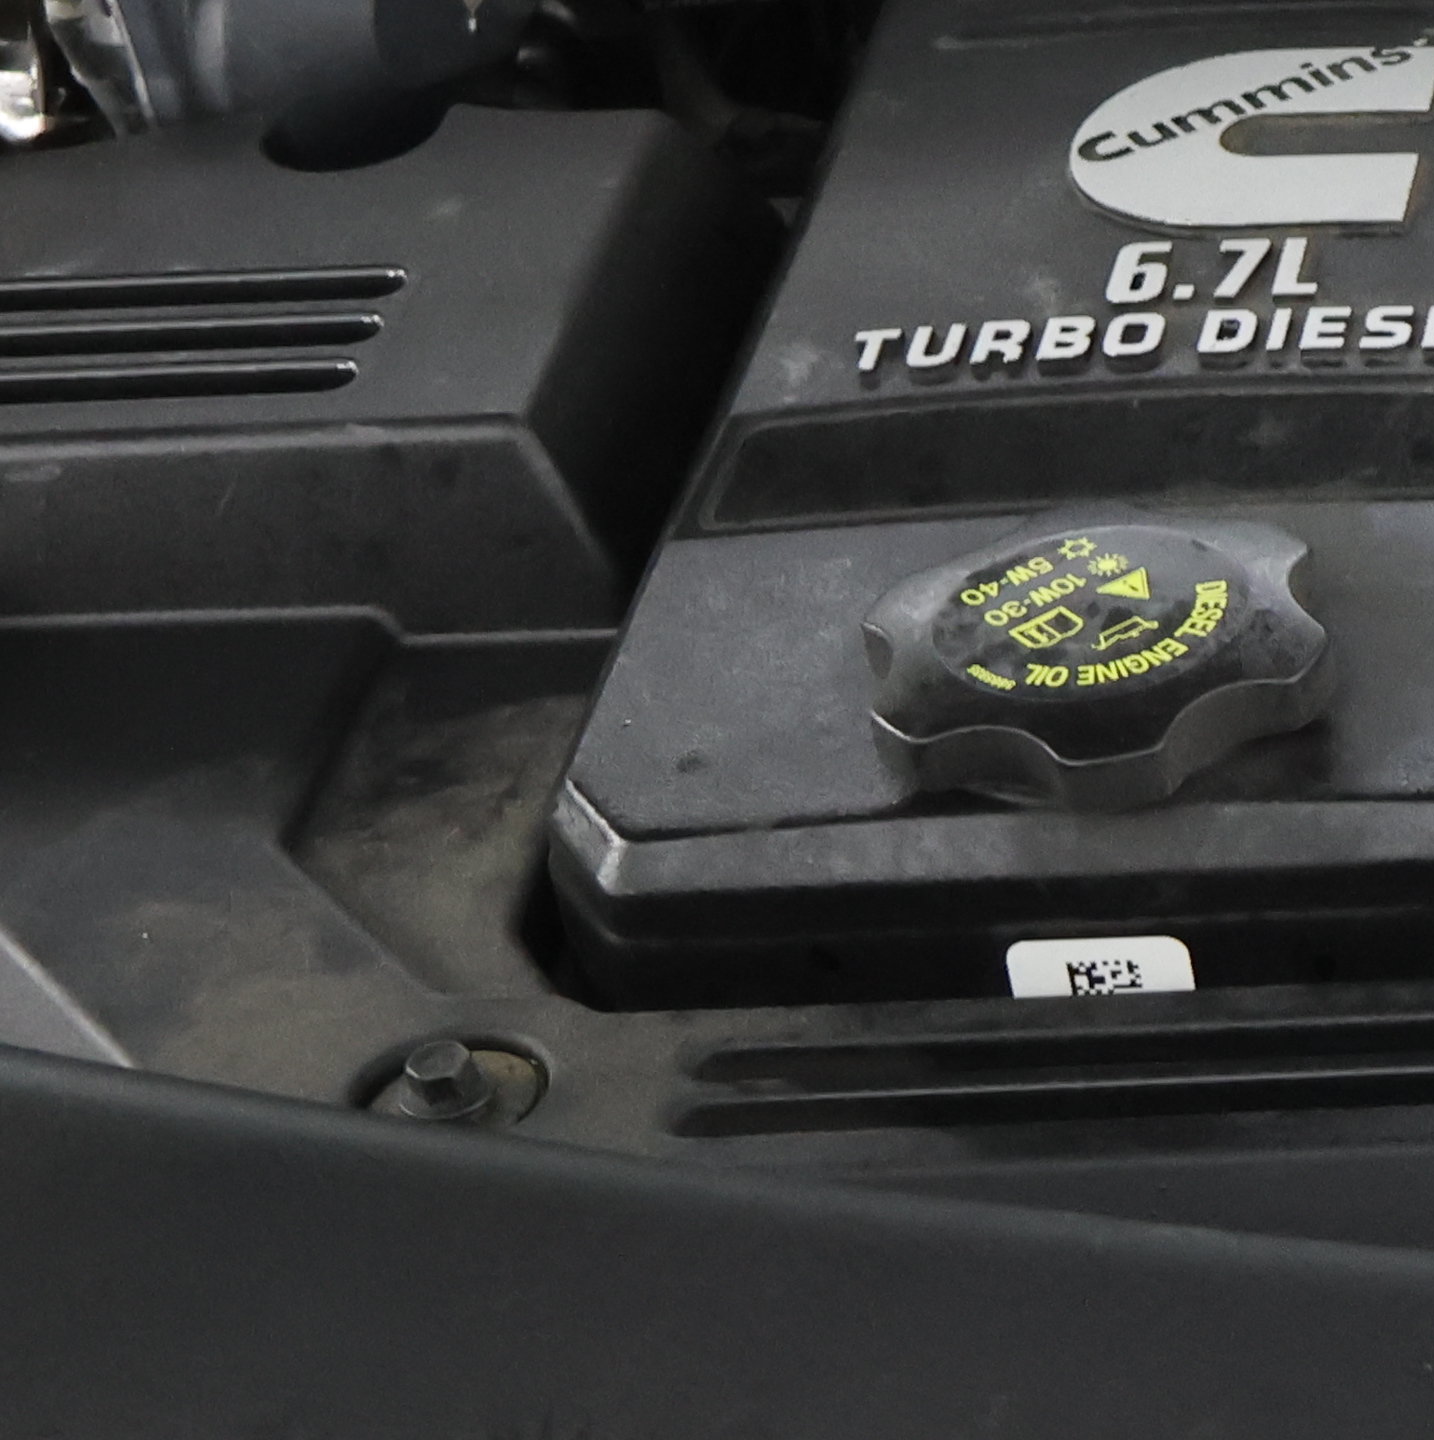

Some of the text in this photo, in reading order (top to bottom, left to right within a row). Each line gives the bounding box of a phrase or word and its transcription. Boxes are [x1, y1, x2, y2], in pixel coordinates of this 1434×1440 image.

[1077, 46, 1416, 162] Cummins
[1105, 237, 1318, 304] 6.7L
[855, 312, 1167, 372] TURBO
[960, 557, 1054, 606] 5W-40
[984, 573, 1087, 627] 10W-30
[1174, 580, 1229, 637] DIESEL
[1025, 663, 1070, 687] OIL
[1076, 637, 1189, 686] ENGINE
